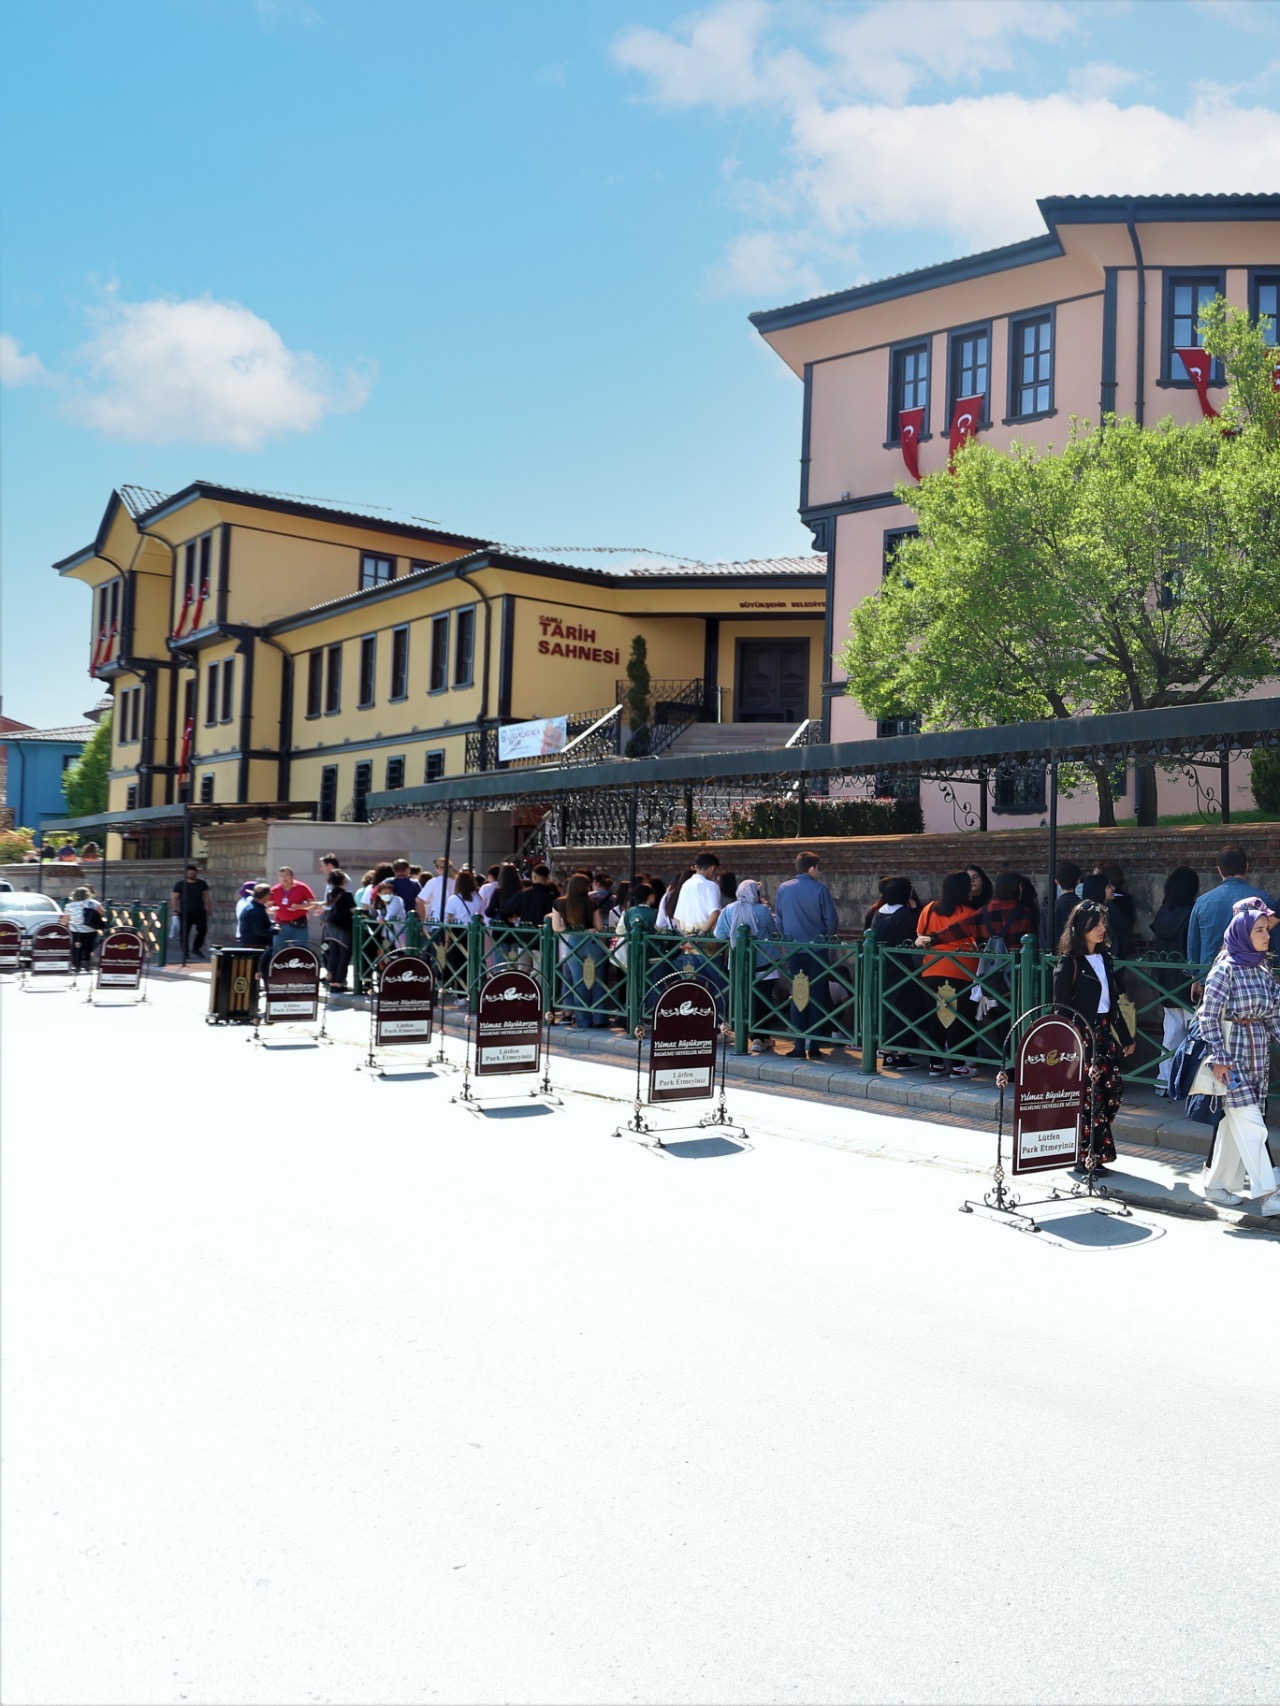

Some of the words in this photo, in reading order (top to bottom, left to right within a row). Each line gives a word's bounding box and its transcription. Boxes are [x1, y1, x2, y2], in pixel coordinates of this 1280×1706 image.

[539, 621, 596, 643] TARİH
[538, 640, 620, 665] SAHNESİ
[1020, 1091, 1044, 1101] Yılmaz
[1038, 1133, 1060, 1141] Lütfen
[1022, 1145, 1038, 1153] Park
[1040, 1141, 1074, 1152] Etmeyiniz
